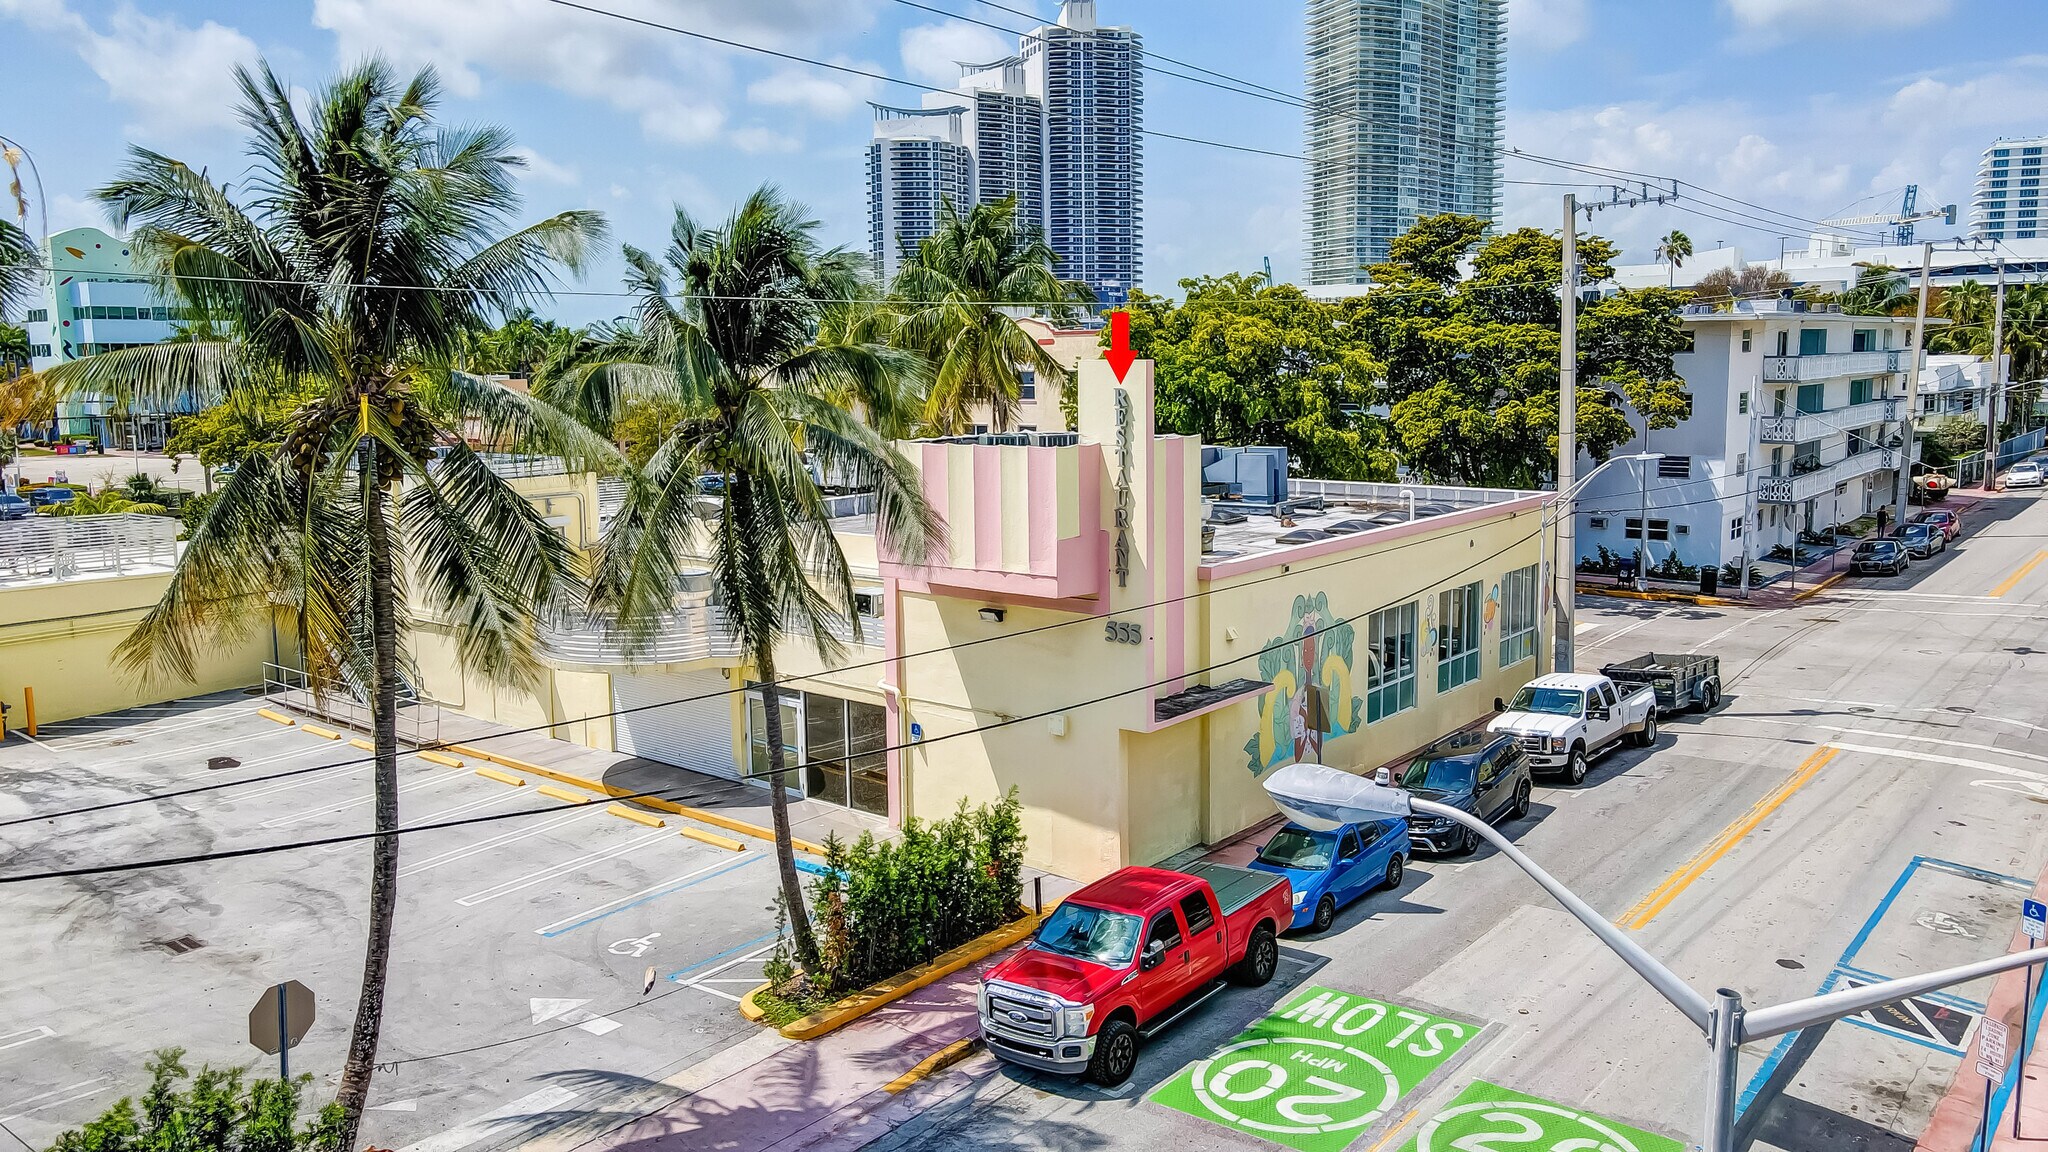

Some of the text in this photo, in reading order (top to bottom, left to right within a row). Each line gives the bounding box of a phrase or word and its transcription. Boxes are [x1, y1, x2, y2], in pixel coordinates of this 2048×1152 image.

[1113, 387, 1130, 588] RESTAURANT
[1105, 620, 1142, 646] 555
[1280, 991, 1464, 1057] SLOW
[1289, 1049, 1348, 1073] MPH
[1208, 1060, 1367, 1125] 20
[1449, 1112, 1617, 1152] 2
